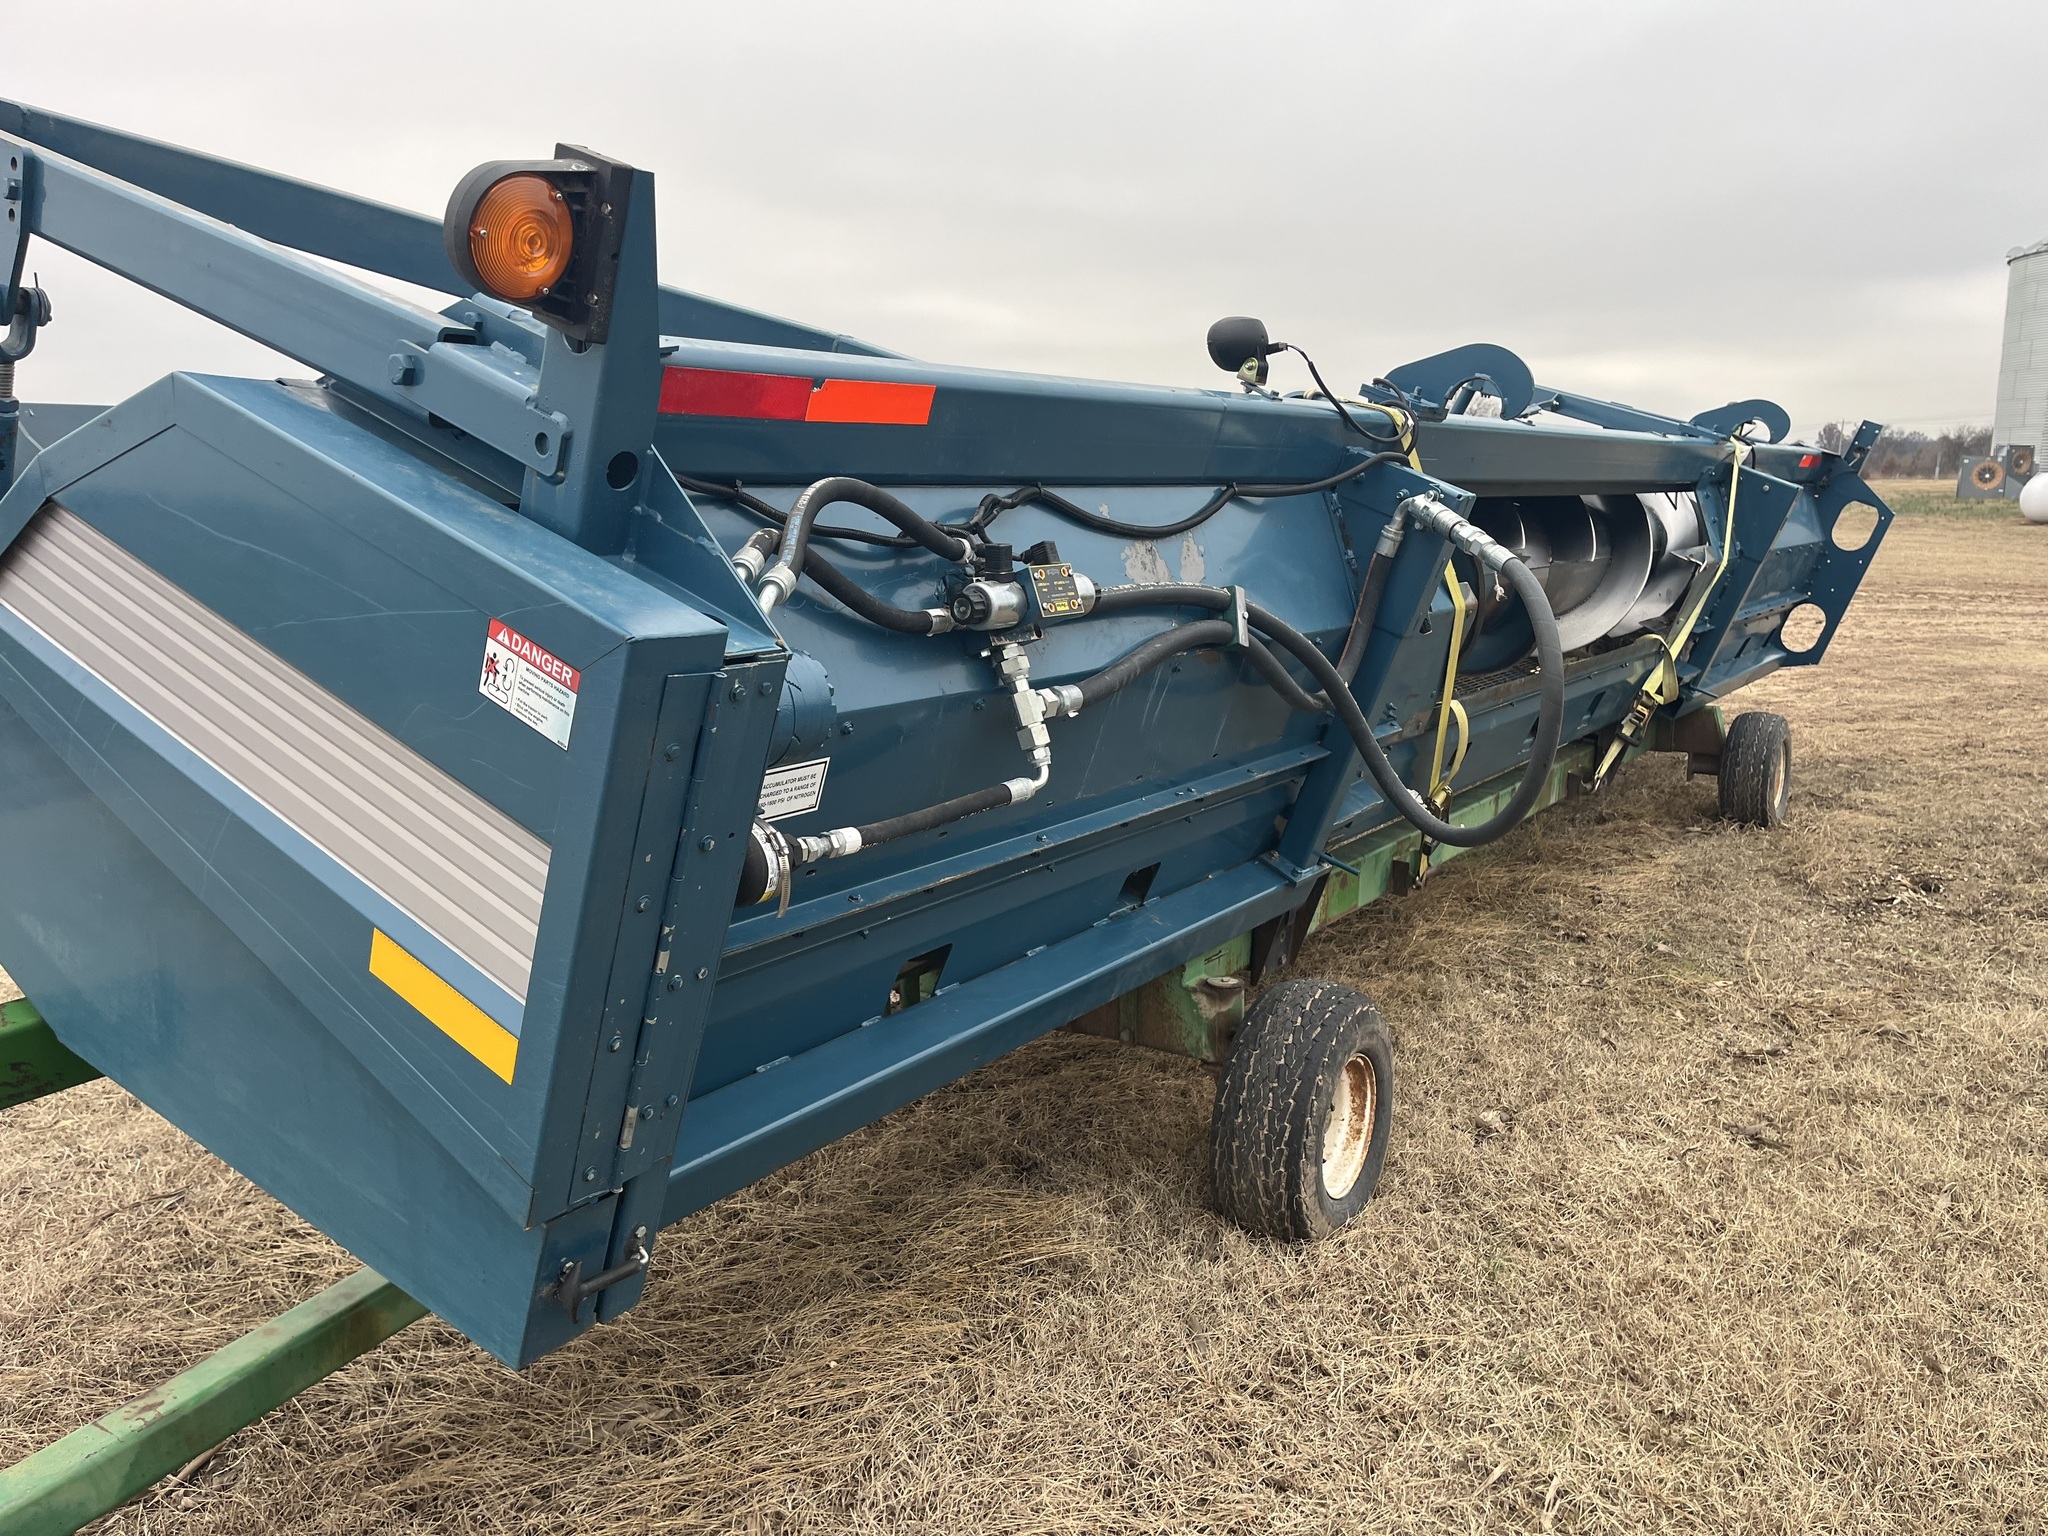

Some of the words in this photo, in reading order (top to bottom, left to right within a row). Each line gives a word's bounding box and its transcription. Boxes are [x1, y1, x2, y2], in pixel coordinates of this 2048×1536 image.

[511, 633, 573, 686] DANGER
[525, 667, 540, 679] MOVING
[541, 677, 553, 688] PARTS
[554, 685, 569, 698] HAZARD
[763, 777, 796, 789] ACCUMULATOR
[760, 789, 782, 799] CHARGED
[793, 791, 816, 799] NITROGEN
